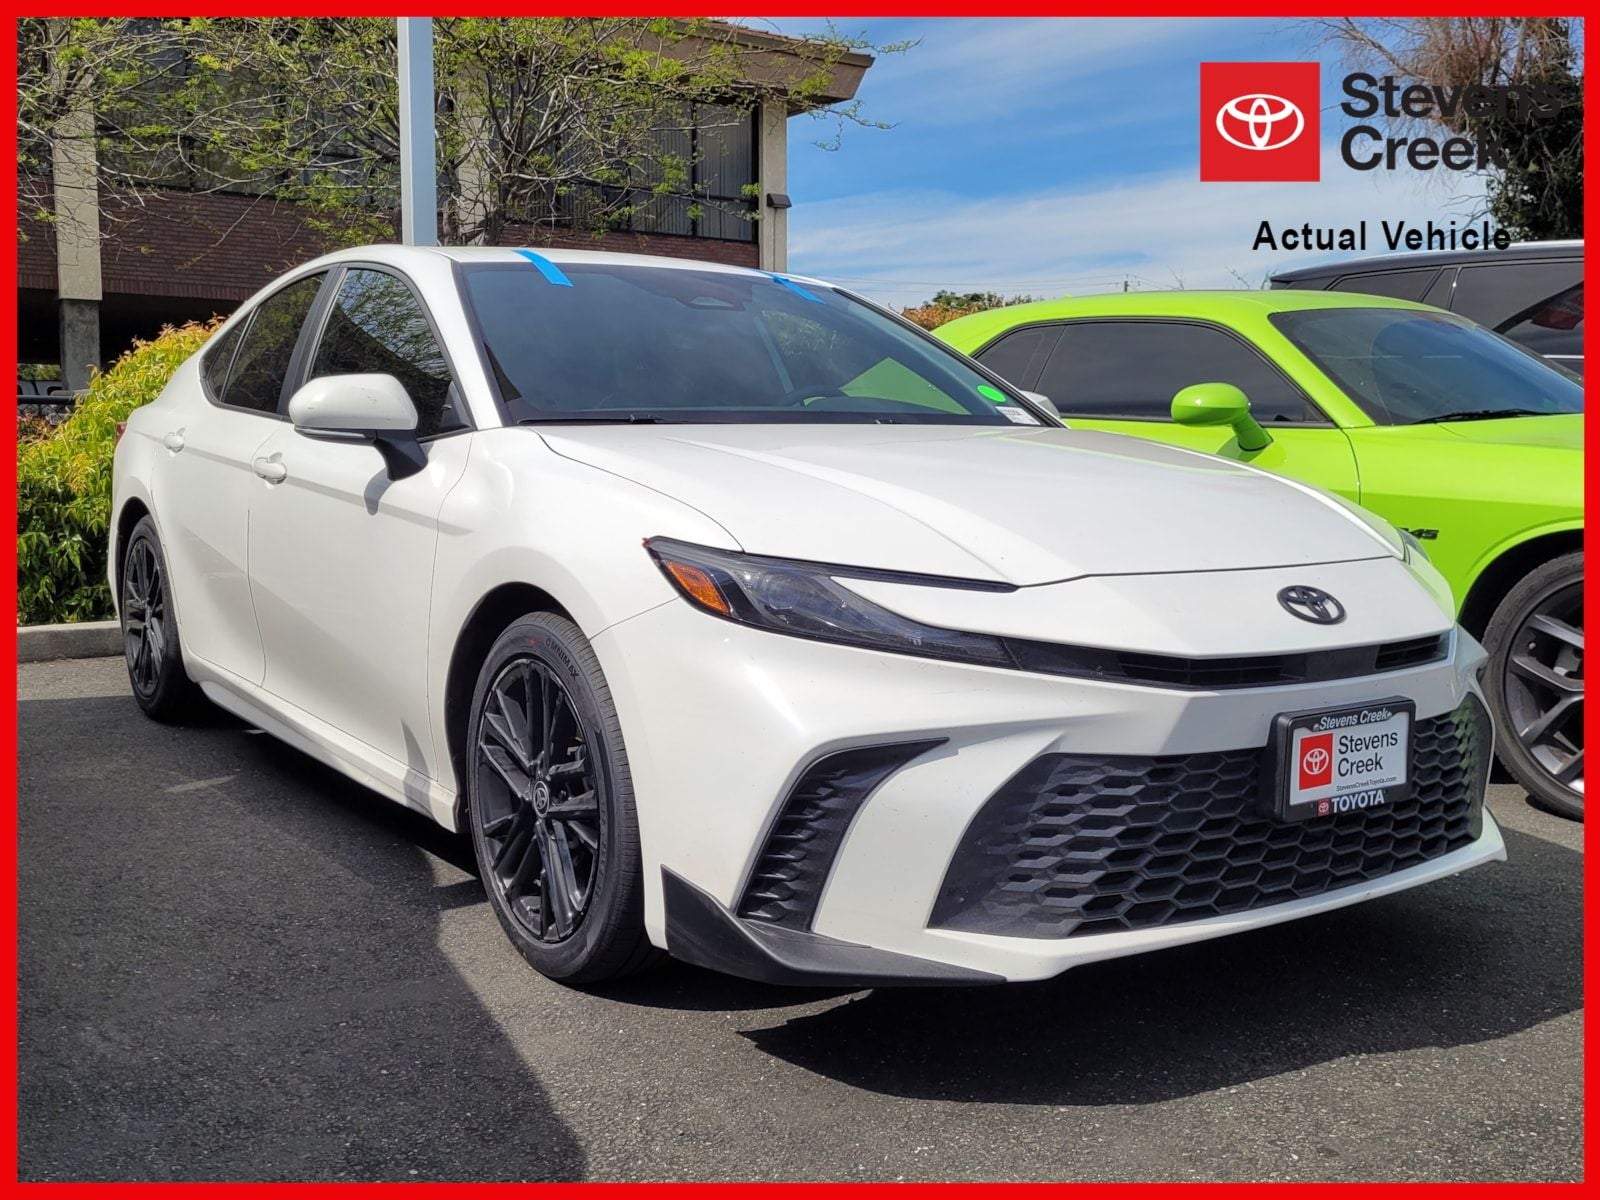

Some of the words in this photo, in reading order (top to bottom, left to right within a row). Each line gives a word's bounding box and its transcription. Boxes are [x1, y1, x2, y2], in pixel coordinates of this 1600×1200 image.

[545, 637, 580, 681] OMNIMAX
[1319, 715, 1358, 731] Stevens
[1360, 708, 1389, 724] Creek
[1338, 731, 1398, 755] Stevens
[1337, 752, 1384, 777] Creek
[1335, 776, 1397, 792] StevensCreekToyota.com
[1331, 789, 1385, 814] TOYOTA
